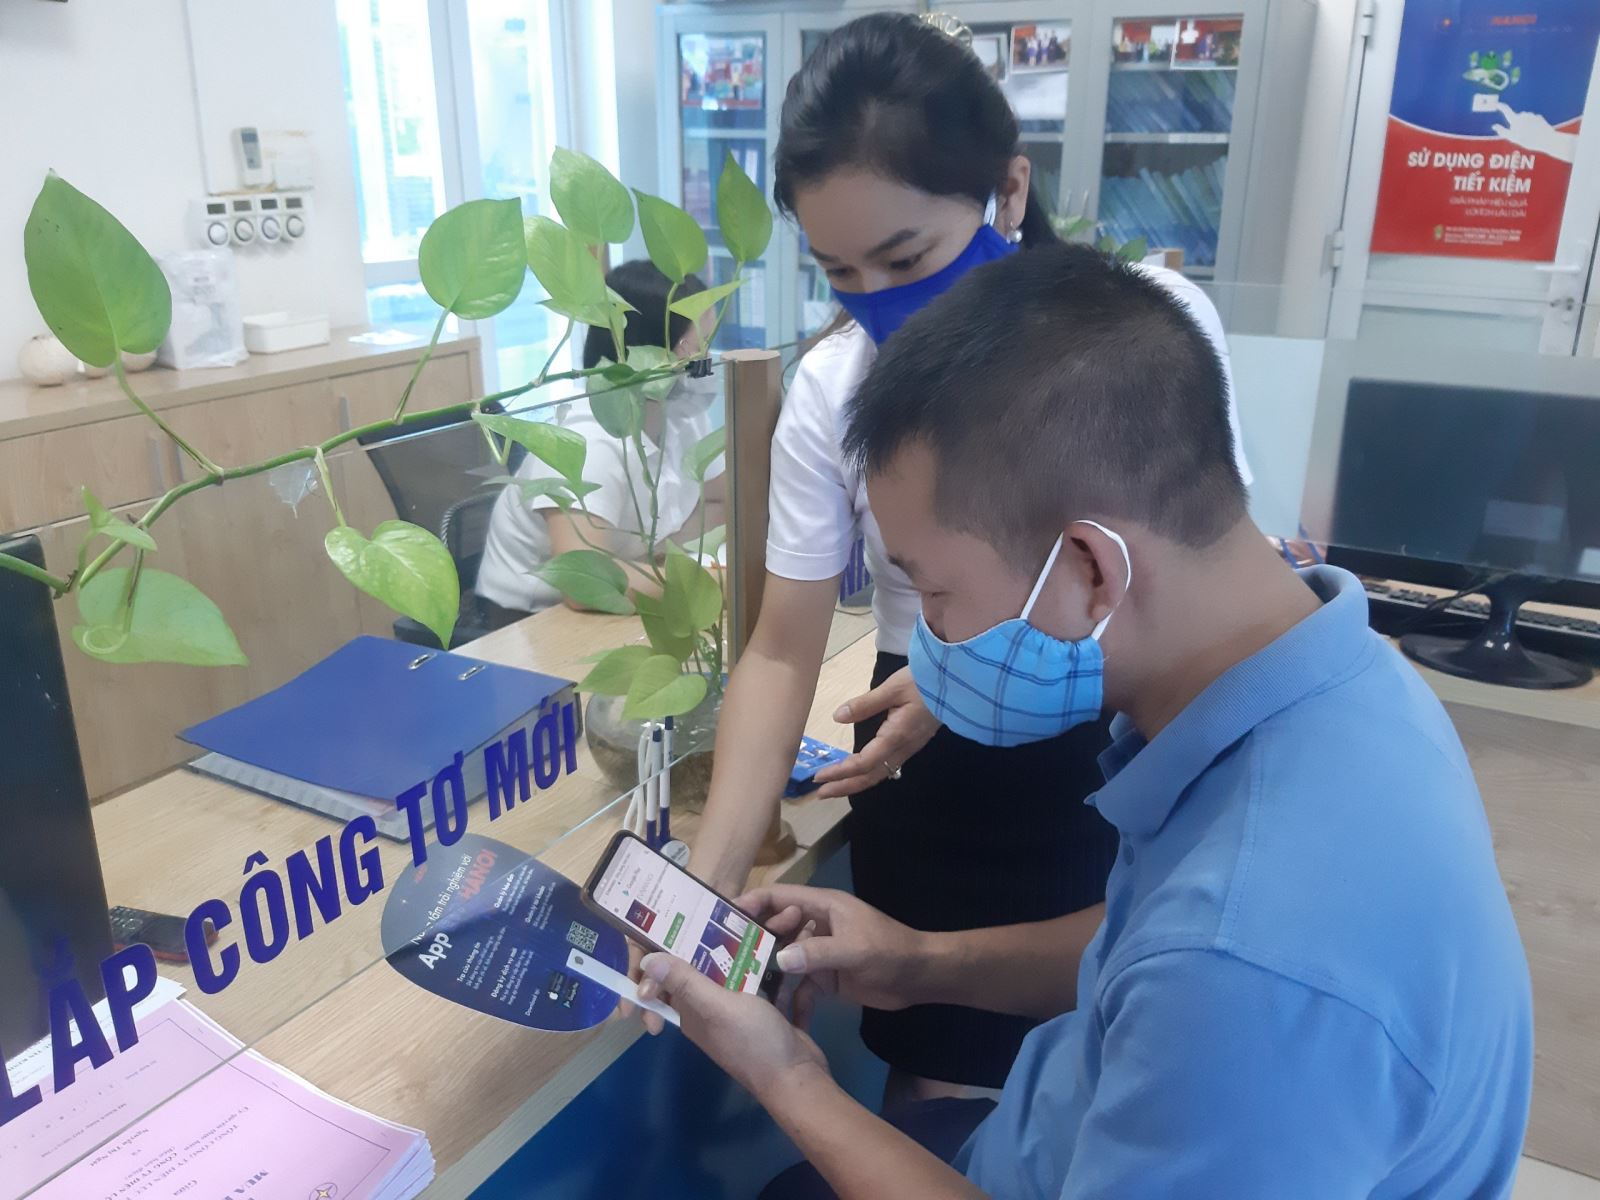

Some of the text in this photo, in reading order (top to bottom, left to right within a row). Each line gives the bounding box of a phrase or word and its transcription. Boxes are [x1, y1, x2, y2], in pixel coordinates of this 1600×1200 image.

[1407, 147, 1535, 174] SỬ DỤNG ĐIỆN
[1453, 170, 1531, 197] TIẾT KIỆM
[184, 815, 385, 996] CÔNG
[396, 750, 468, 867] TƠ
[484, 695, 578, 822] MỚI
[419, 933, 453, 969] App
